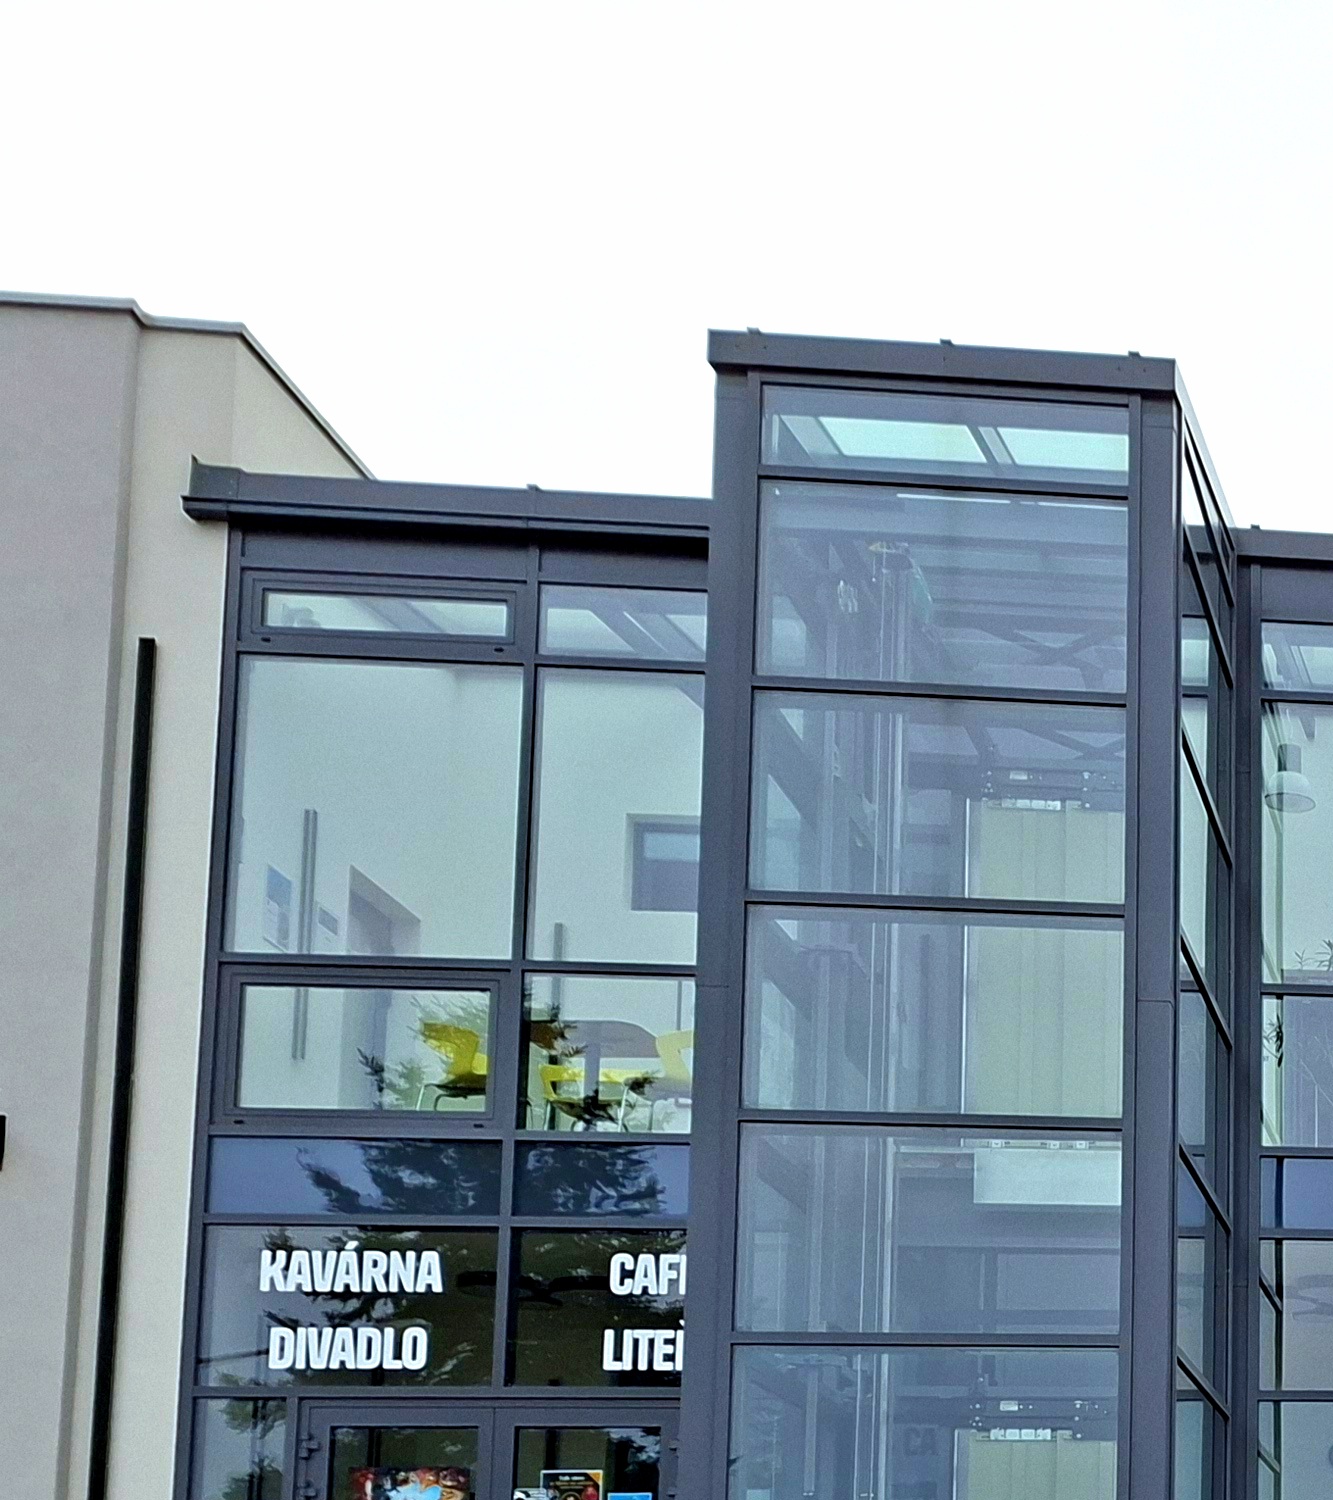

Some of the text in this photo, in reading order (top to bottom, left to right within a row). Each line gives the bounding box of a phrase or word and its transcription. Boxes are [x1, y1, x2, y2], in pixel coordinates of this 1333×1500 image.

[259, 1240, 444, 1293] KAVÁRNA
[609, 1252, 687, 1296] CAF
[267, 1325, 429, 1371] DIVADLO
